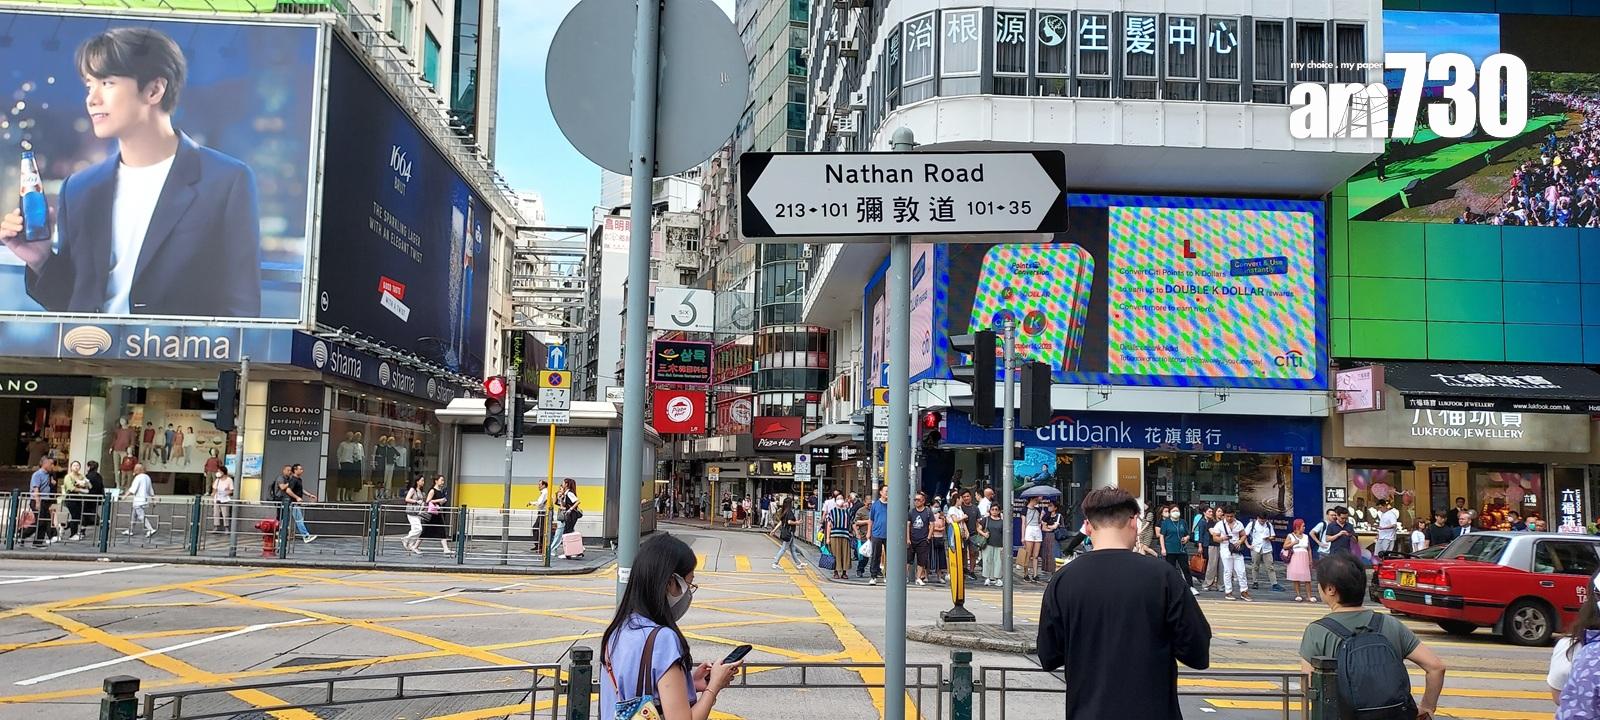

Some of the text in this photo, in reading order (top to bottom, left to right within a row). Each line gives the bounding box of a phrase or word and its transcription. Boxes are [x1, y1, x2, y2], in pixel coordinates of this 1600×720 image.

[825, 163, 984, 183] Nathan Road
[775, 196, 1031, 223] 213 101 彌敦道 101 35
[390, 231, 409, 255] ELEGANT
[407, 228, 421, 248] LAGER
[1120, 267, 1148, 276] Convert
[1165, 284, 1209, 295] DOUBLE
[1212, 285, 1219, 295] K
[1221, 286, 1265, 297] DOLLAR
[1120, 303, 1148, 311] Convert
[126, 328, 229, 359] shama
[331, 349, 362, 379] shama
[1274, 352, 1303, 368] citi
[392, 368, 415, 393] shama
[271, 405, 321, 414] GIORDANO
[1513, 402, 1571, 411] www.lukfook.com.hk
[1036, 420, 1223, 445] citibank 花旗銀行
[1411, 427, 1524, 439] LUKFOOK JEWELLERY
[758, 438, 795, 447] Pizza Hut
